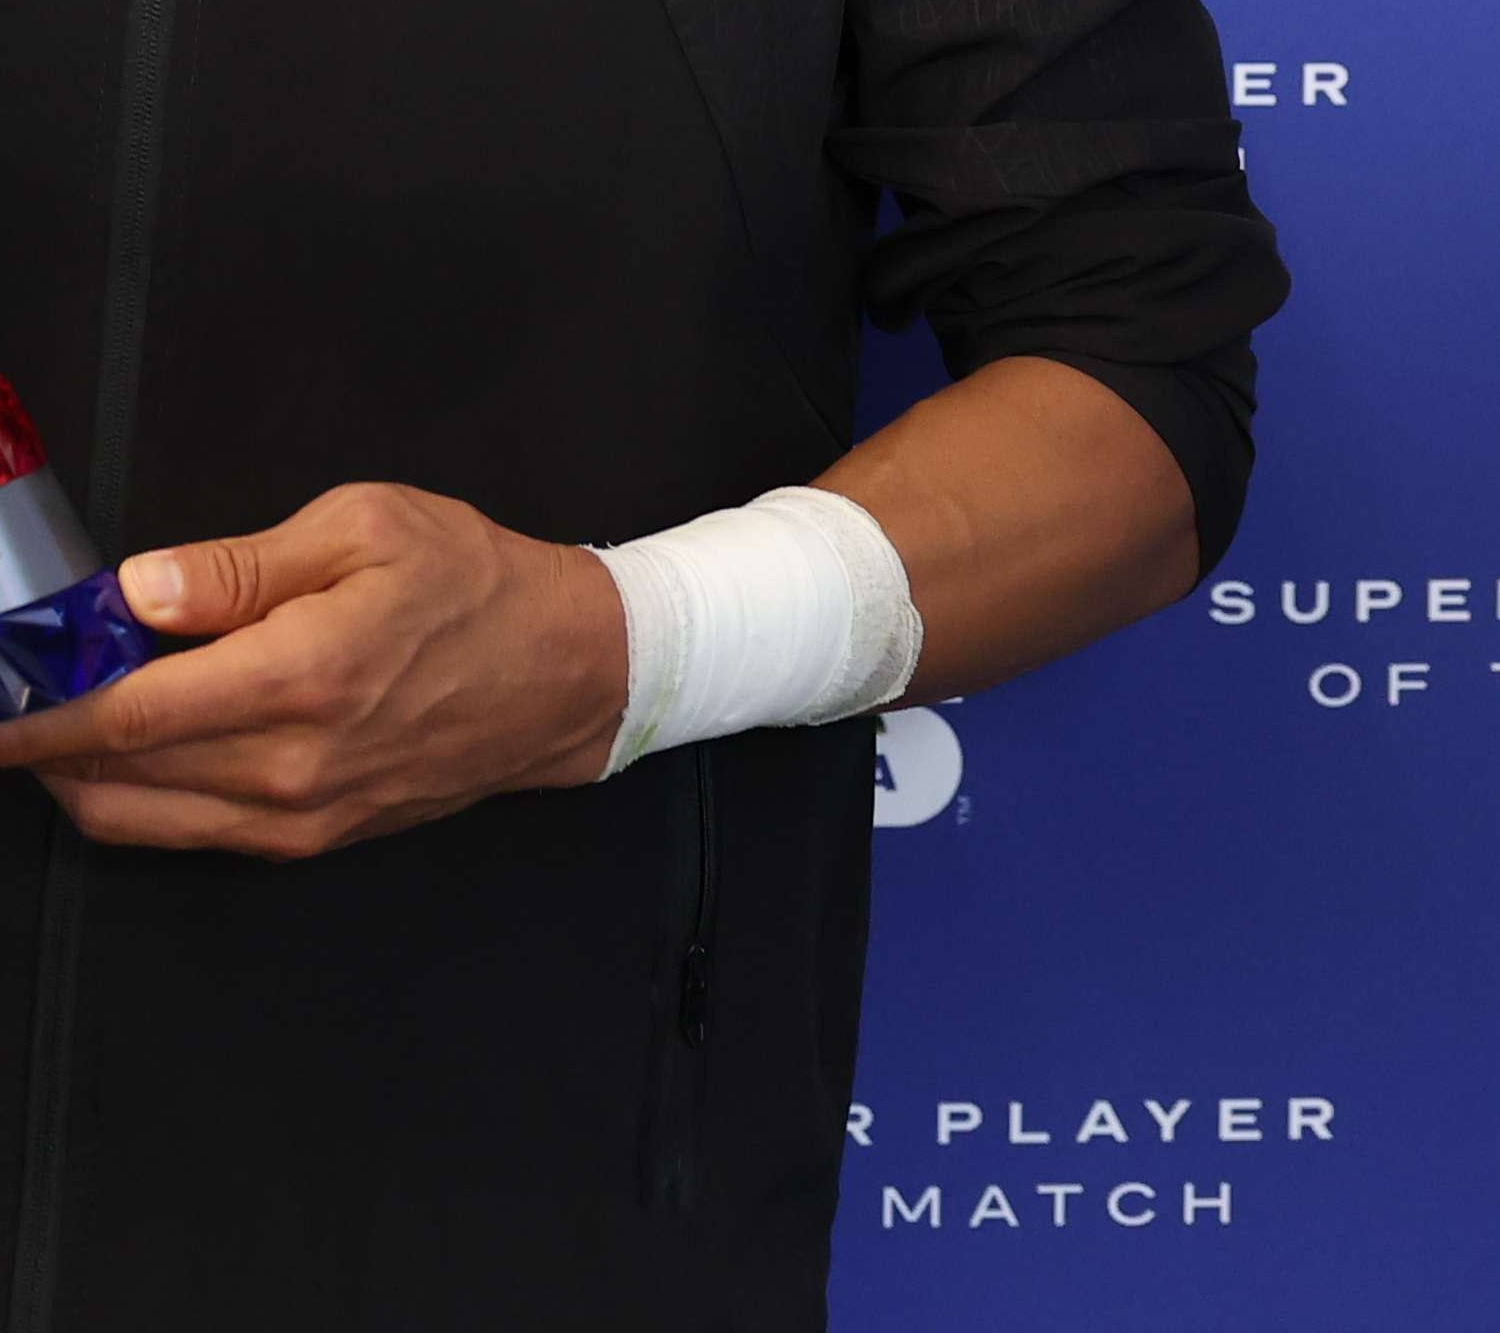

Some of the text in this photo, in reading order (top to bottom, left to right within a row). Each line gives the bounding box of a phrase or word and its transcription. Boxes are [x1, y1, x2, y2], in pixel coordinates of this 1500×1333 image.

[1308, 663, 1431, 707] OF
[937, 1097, 1335, 1145] PLAYER
[882, 1182, 1231, 1229] MATCH
